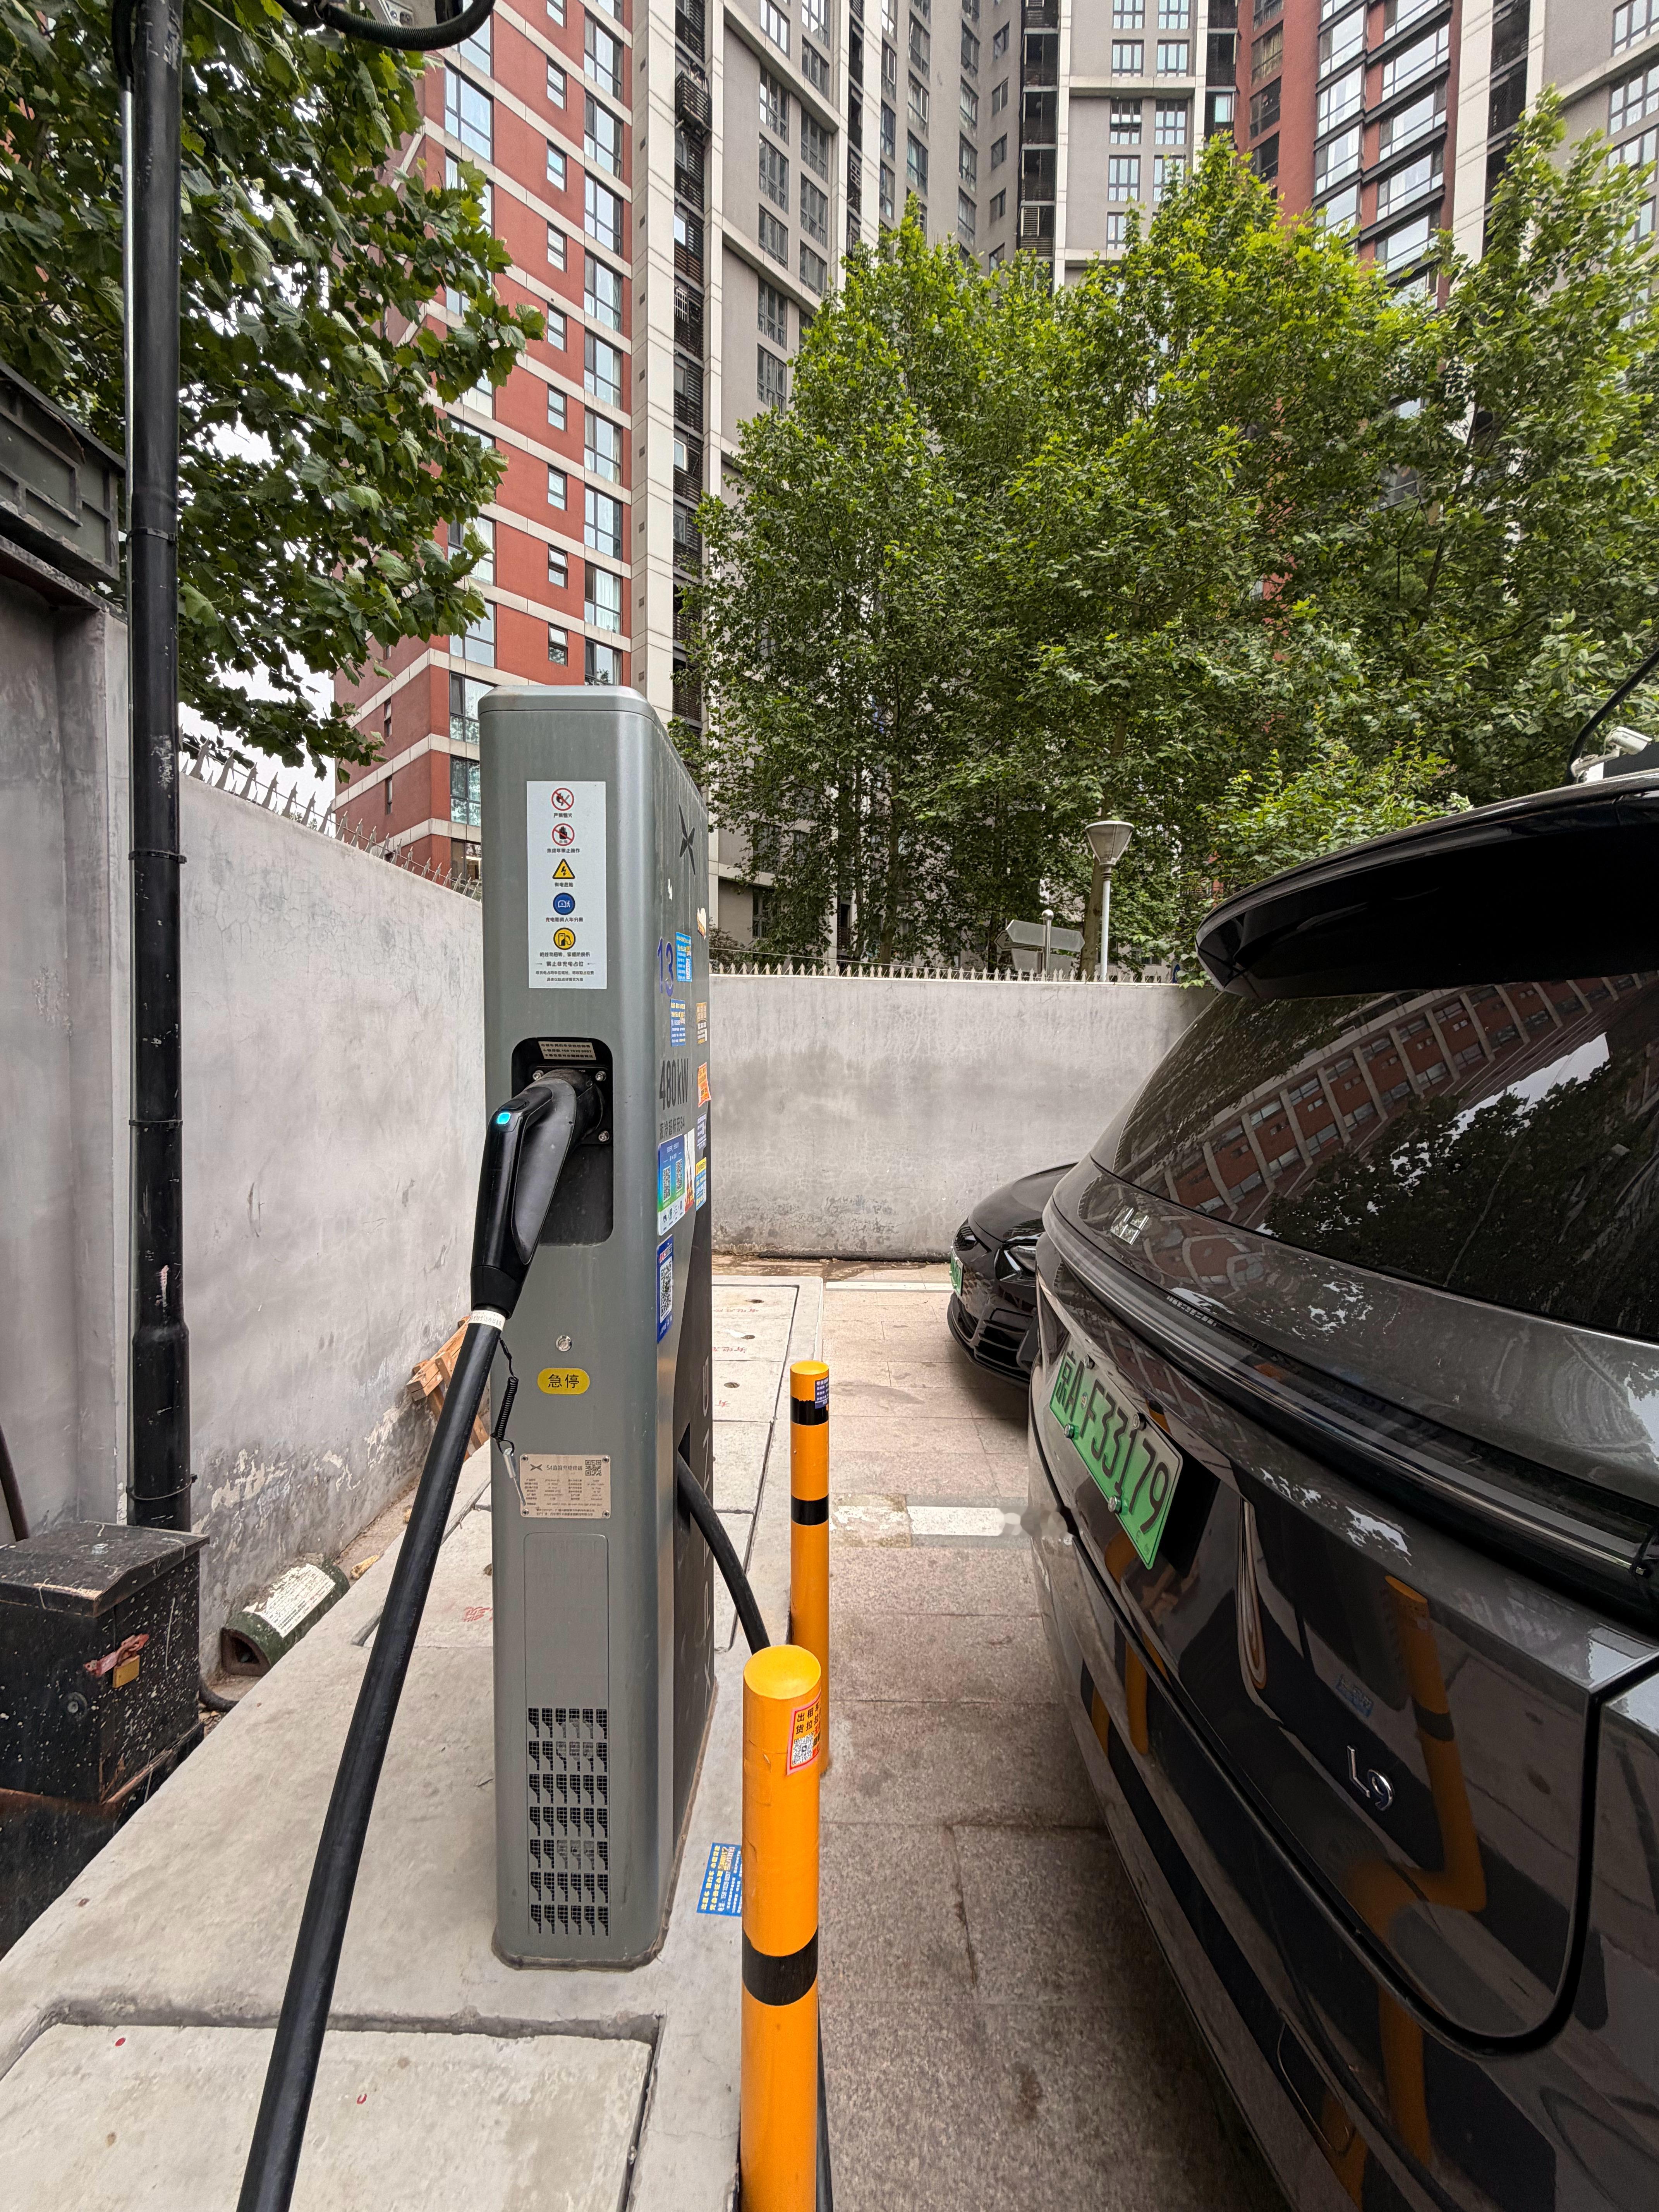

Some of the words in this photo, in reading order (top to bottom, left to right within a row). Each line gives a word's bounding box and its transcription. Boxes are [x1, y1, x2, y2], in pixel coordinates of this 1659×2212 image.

[657, 935, 674, 997] 13
[548, 1374, 580, 1389] 急停
[1347, 1745, 1395, 1812] L9
